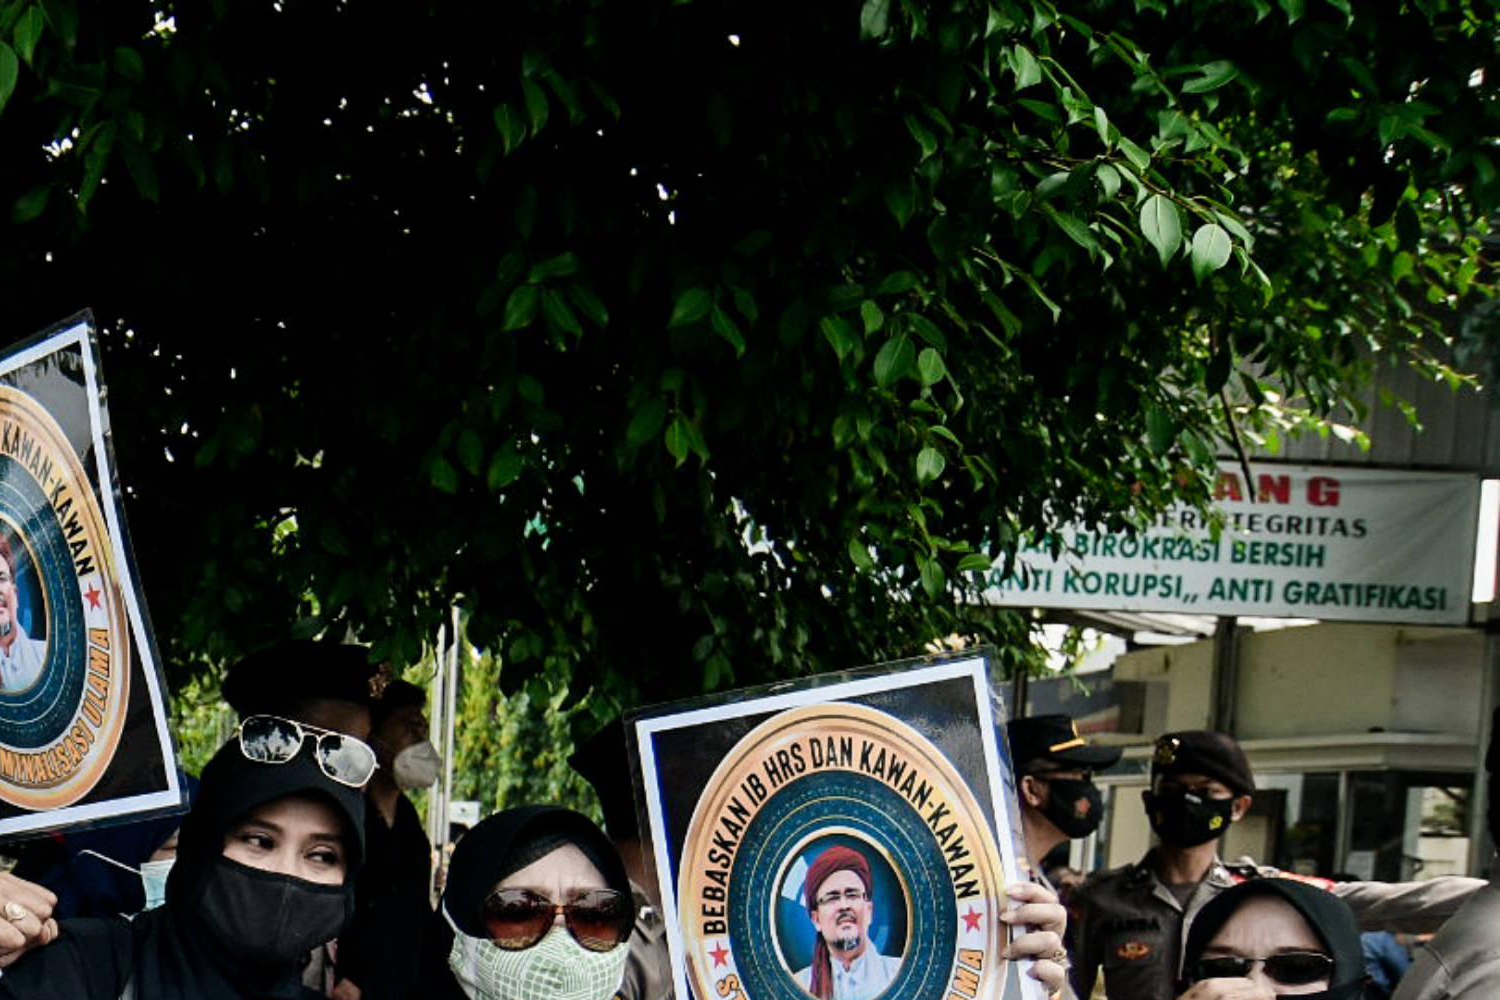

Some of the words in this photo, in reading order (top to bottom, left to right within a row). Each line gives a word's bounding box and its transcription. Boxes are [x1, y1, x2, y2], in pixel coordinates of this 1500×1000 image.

[2, 421, 94, 577] KAWAN-KAWAN
[1212, 471, 1341, 506] ANG
[1231, 541, 1326, 567] BERSIH
[1208, 577, 1273, 603] ANTI
[1283, 580, 1448, 612] GRATIFIKASI
[87, 626, 110, 727] ULAMA
[703, 807, 751, 935] BEBASKAN
[742, 779, 767, 807] IB
[765, 745, 805, 786] HRS
[810, 736, 853, 770] DAN
[859, 740, 982, 901] KAWAN-KAWAN
